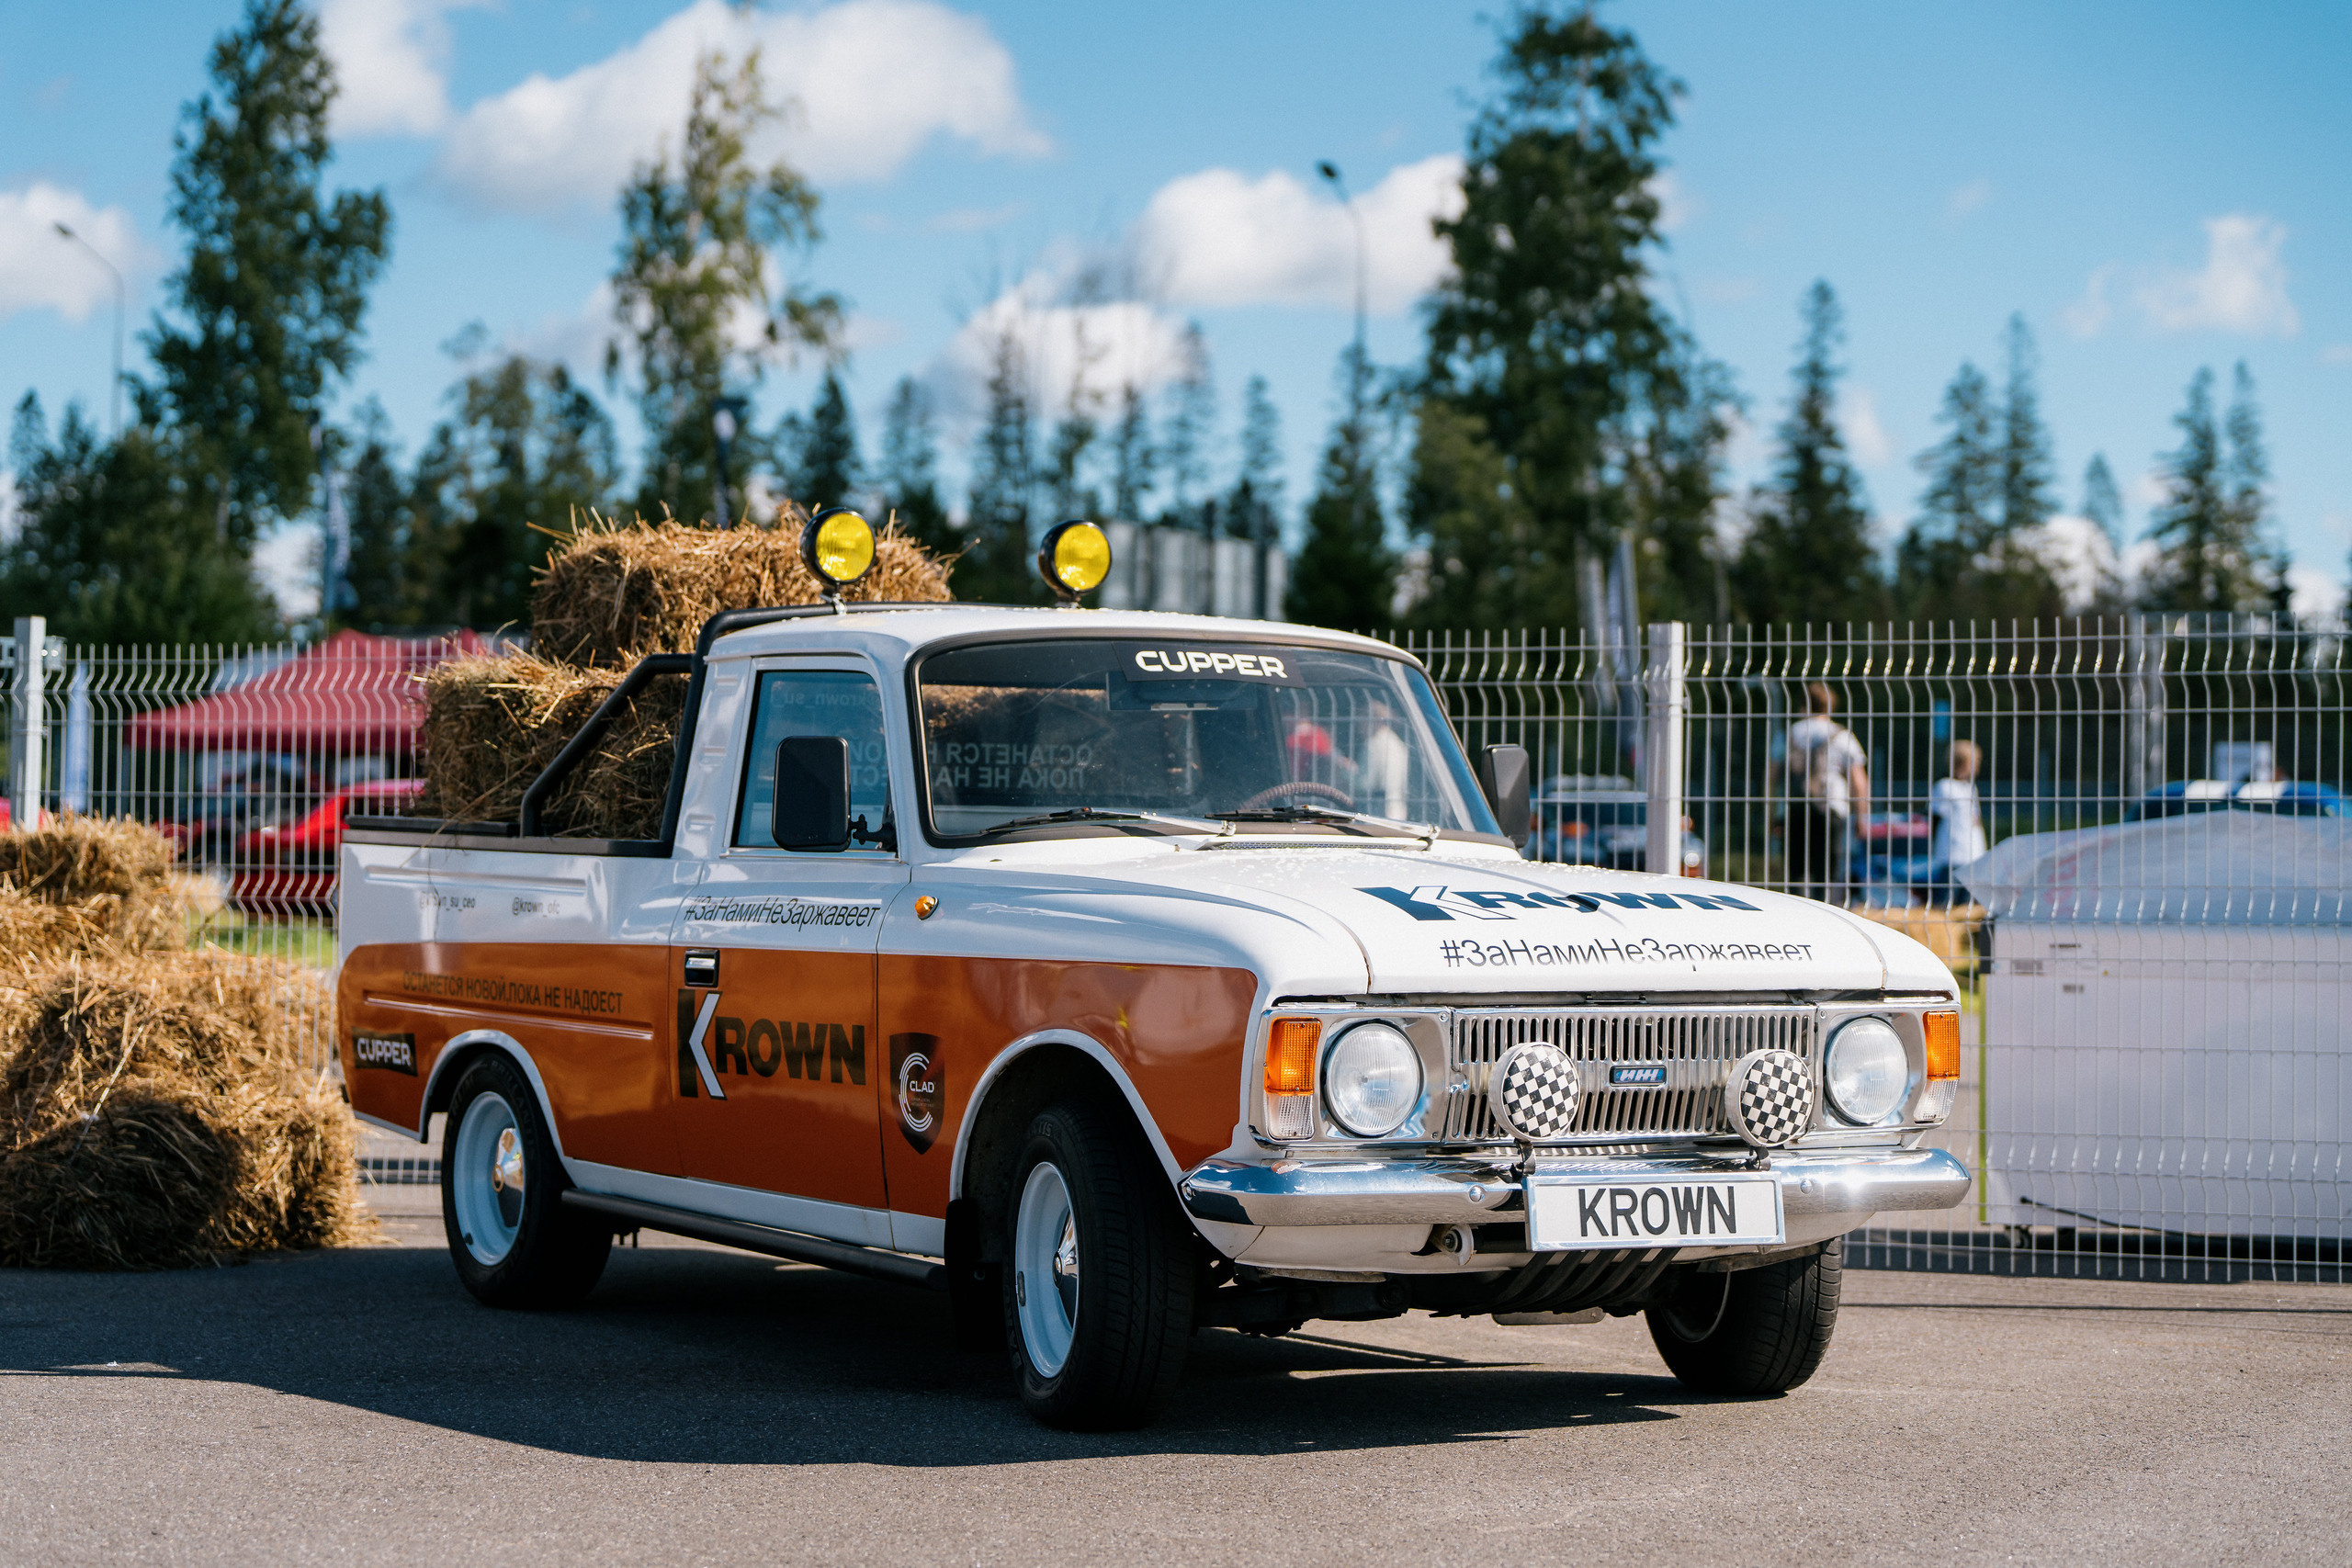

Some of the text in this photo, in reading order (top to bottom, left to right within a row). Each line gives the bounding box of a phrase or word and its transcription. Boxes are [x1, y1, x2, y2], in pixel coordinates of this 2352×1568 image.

[1135, 650, 1288, 679] CUPPER
[684, 896, 880, 932] #ЗаНамиНеЗаржавеет
[1440, 938, 1813, 972] #ЗаНамиНеЗаржавеет
[402, 970, 463, 997] ОСТАНЕТСЯ
[545, 986, 560, 1008] НЕ
[564, 987, 623, 1014] НАДОЕСТ
[357, 1037, 412, 1066] CUPPER
[677, 988, 866, 1100] KROWN
[910, 1080, 935, 1093] CLAD
[1578, 1185, 1737, 1236] KROWN
